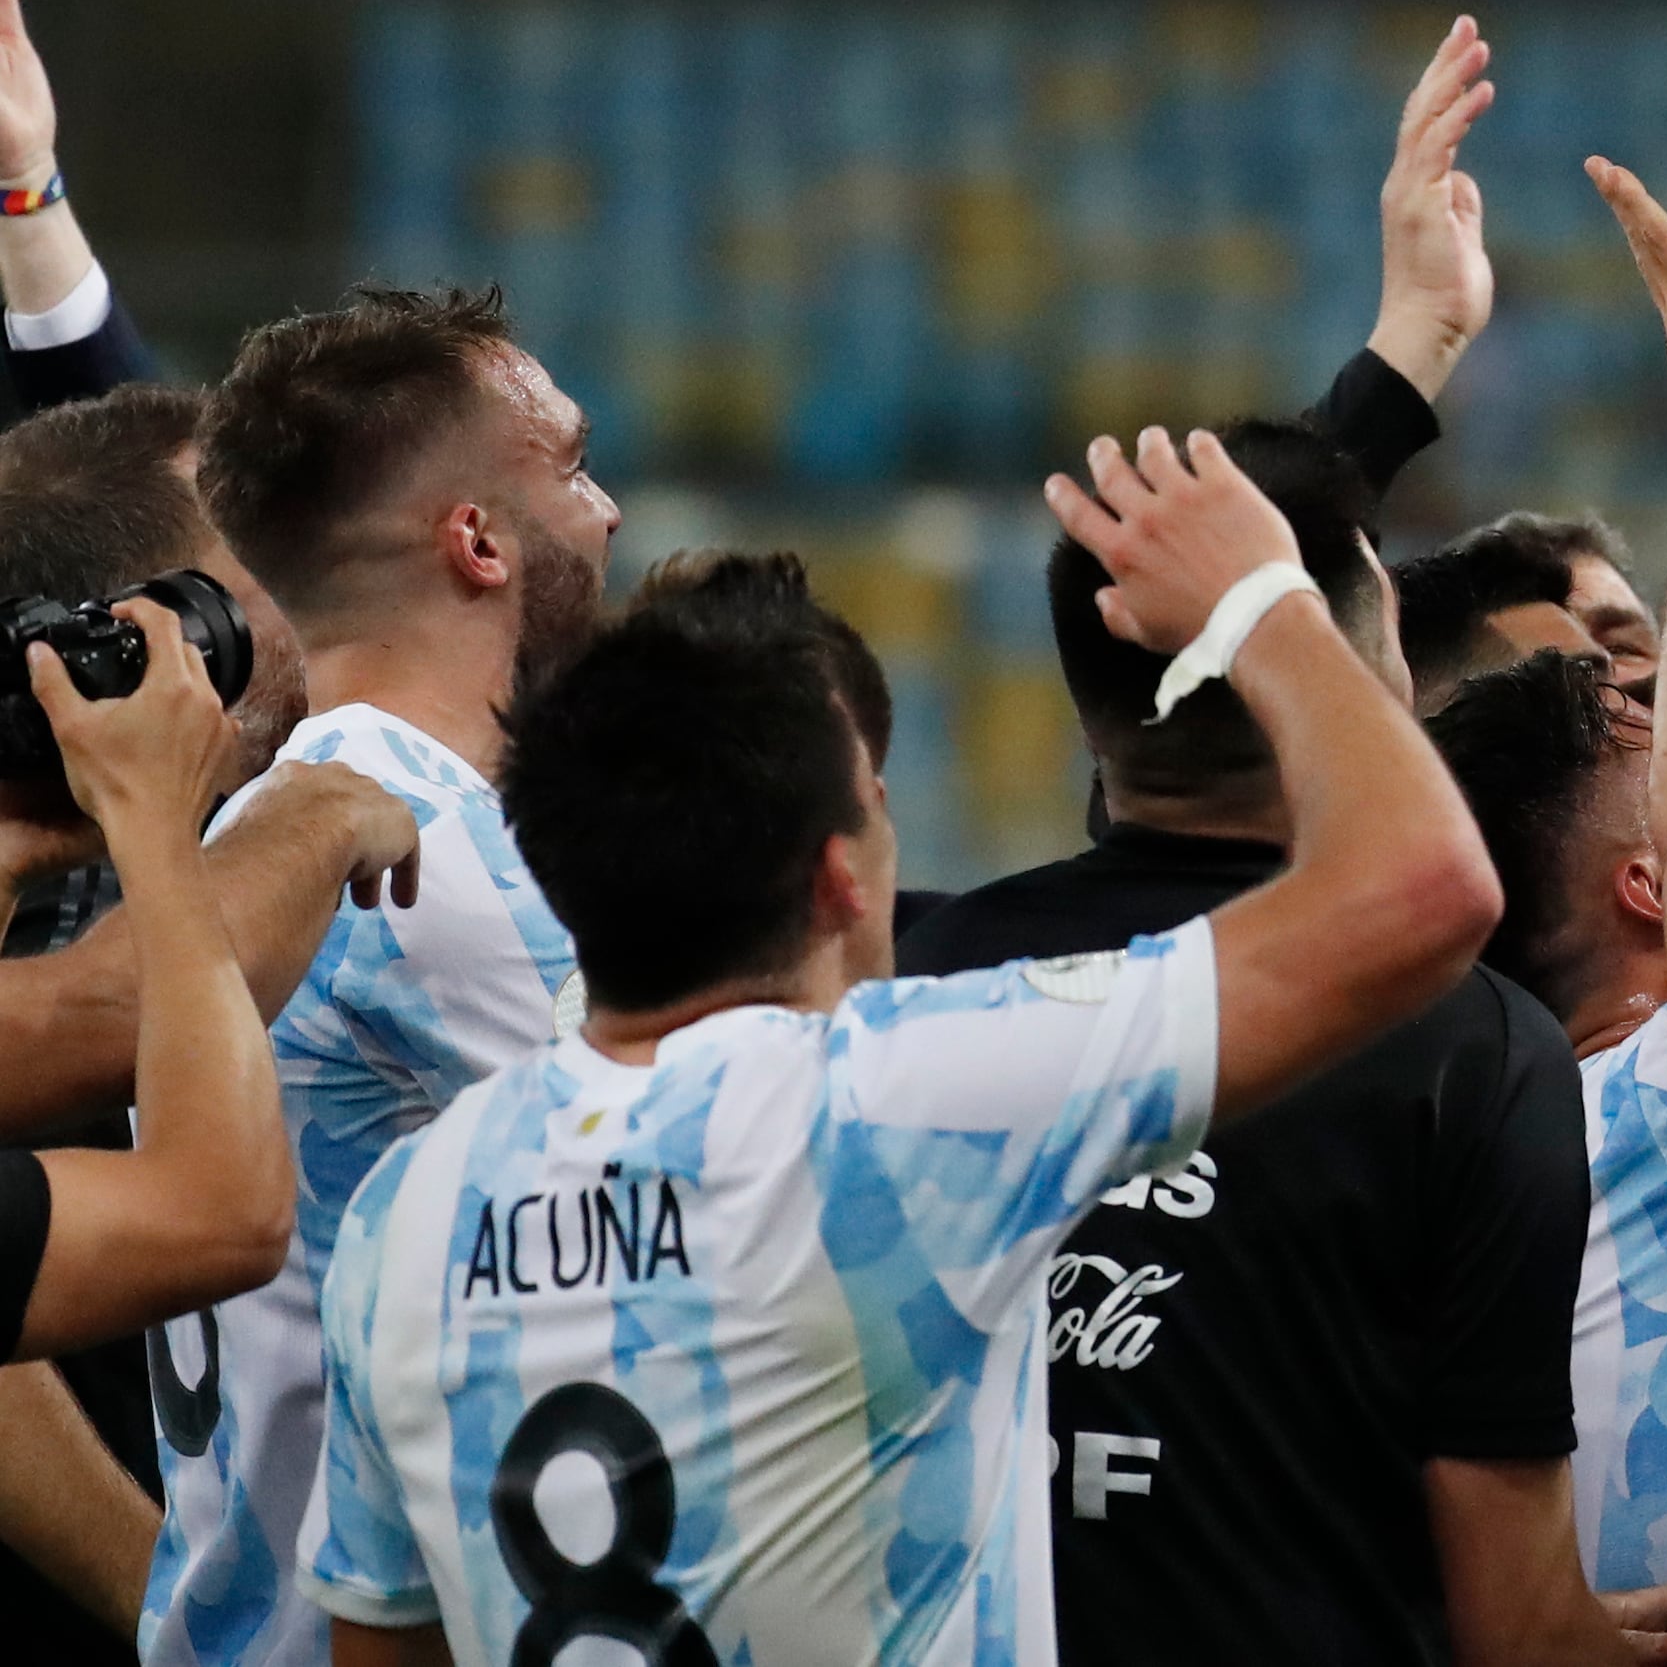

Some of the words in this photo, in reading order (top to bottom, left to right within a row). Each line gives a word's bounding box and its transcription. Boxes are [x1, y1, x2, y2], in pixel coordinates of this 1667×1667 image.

[464, 1161, 692, 1300] ACUÑA
[1047, 1251, 1184, 1372] ola
[489, 1381, 722, 1667] 8
[1049, 1430, 1162, 1521] F
